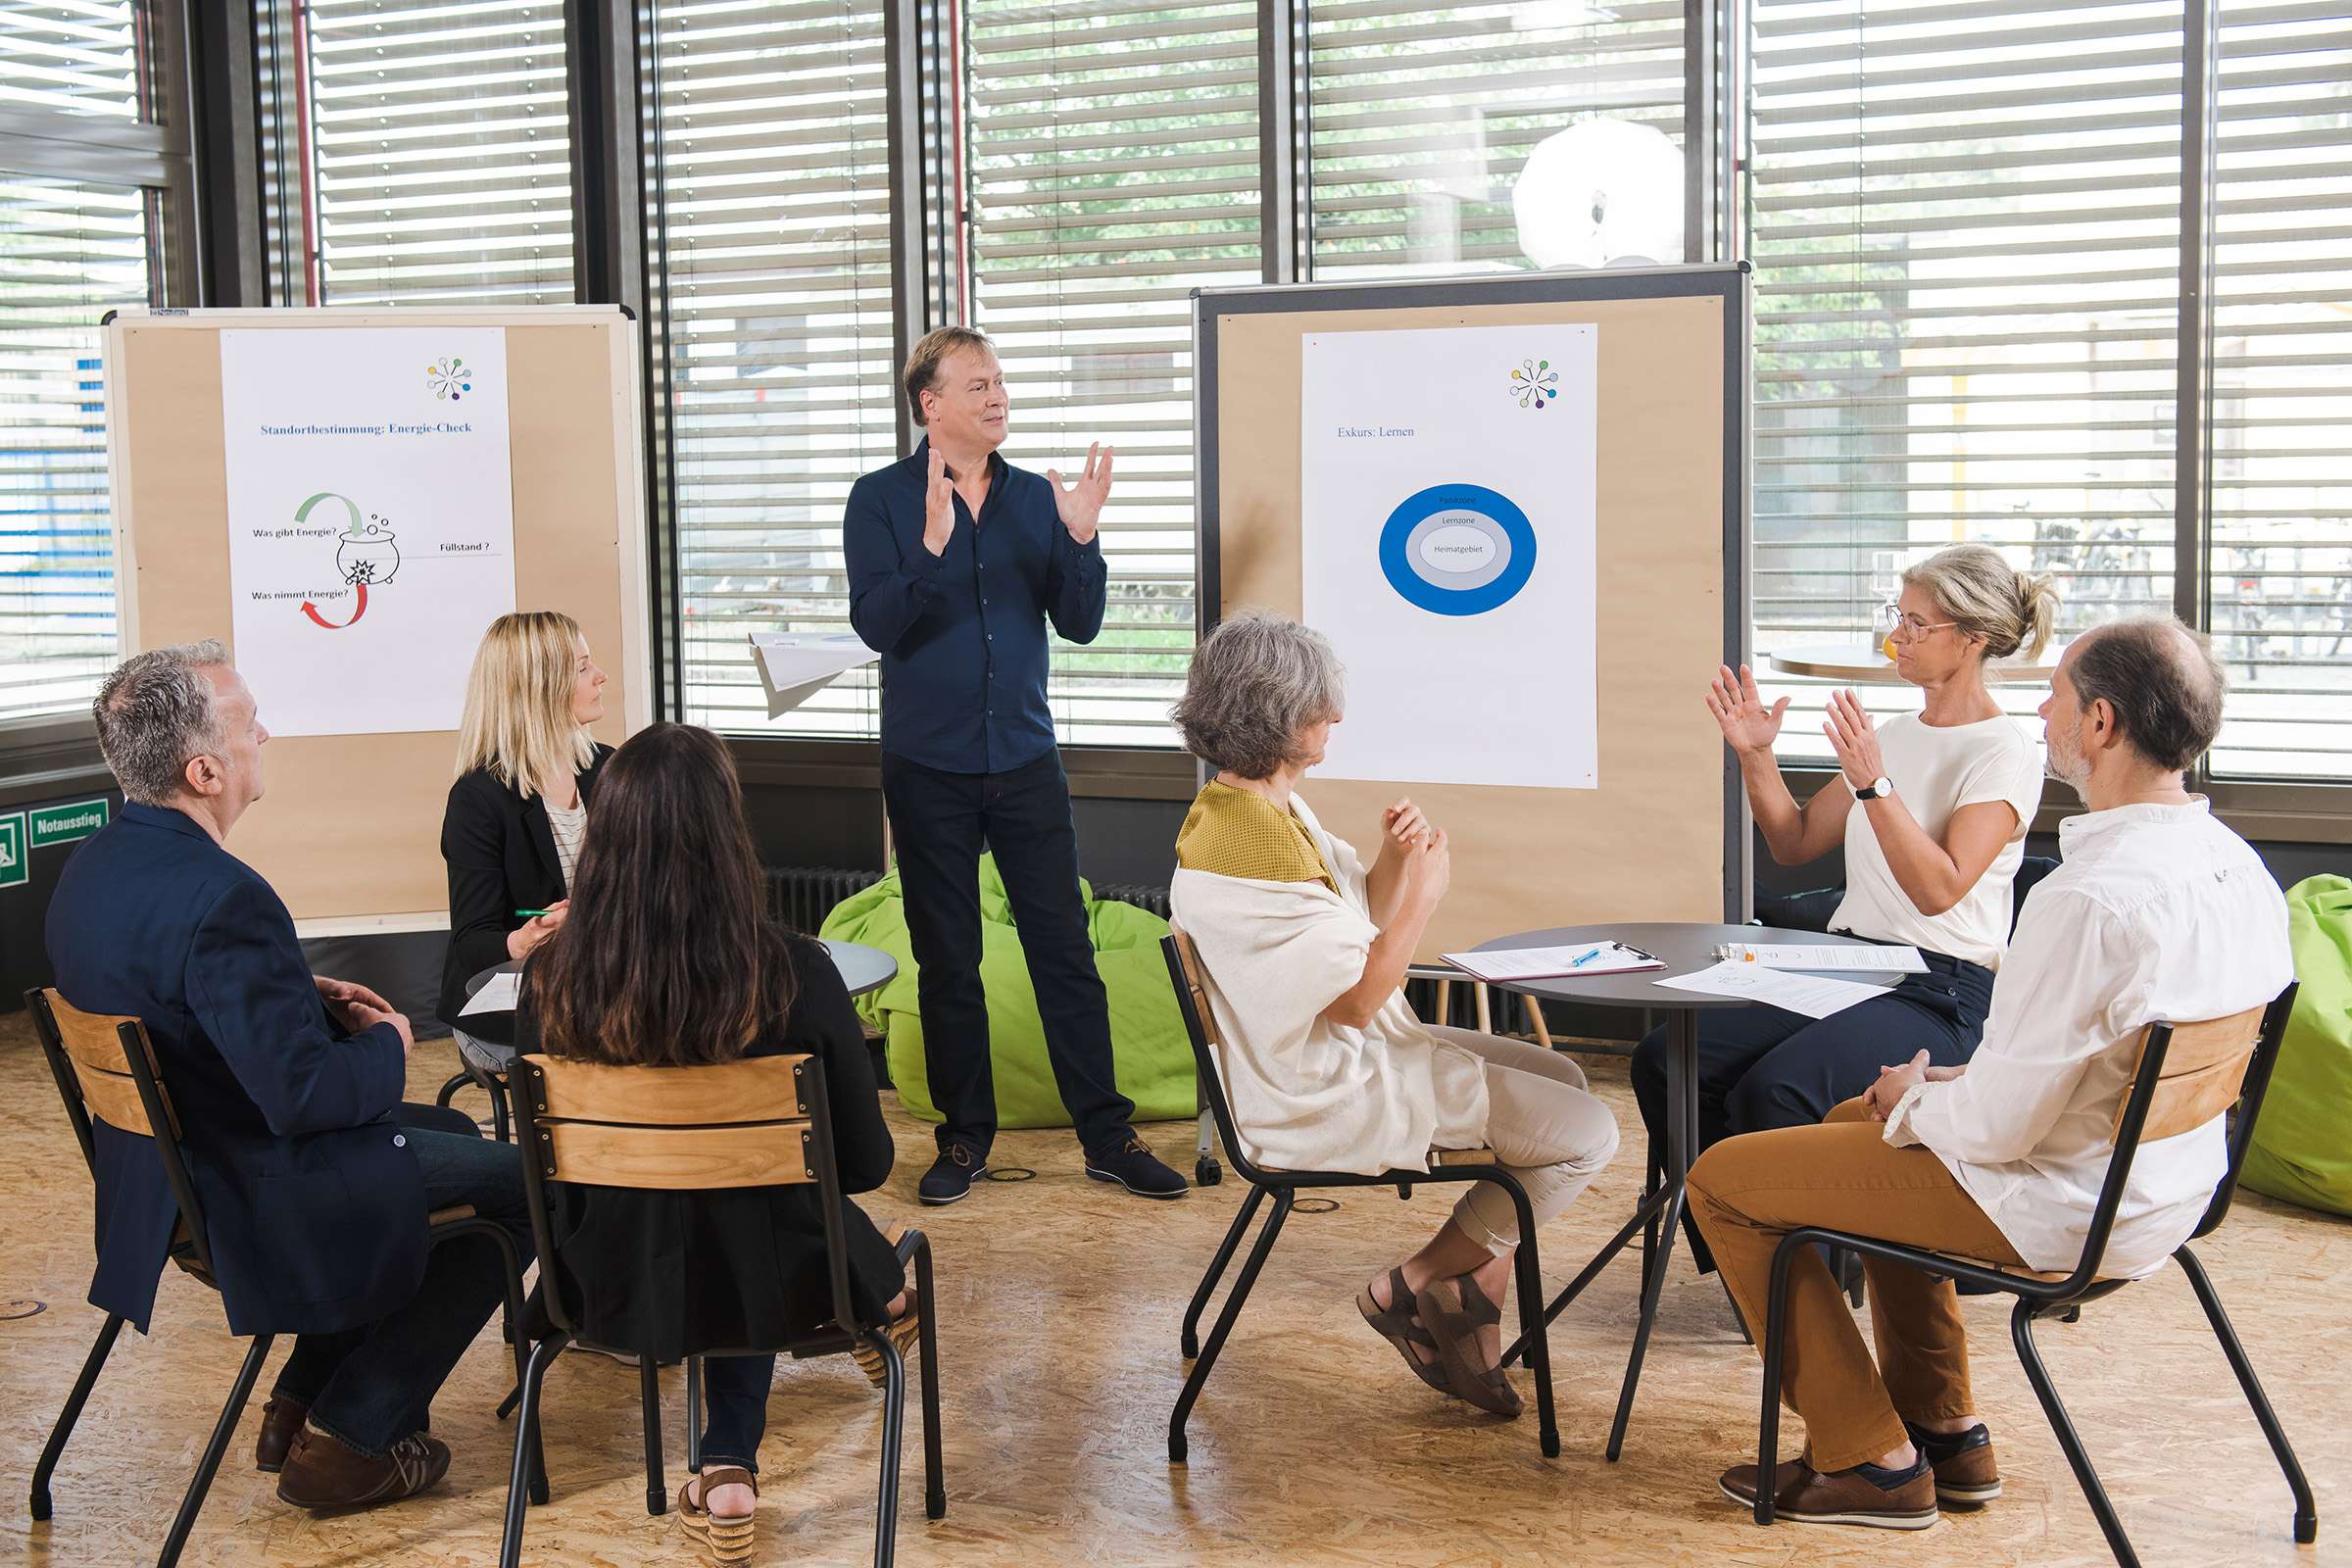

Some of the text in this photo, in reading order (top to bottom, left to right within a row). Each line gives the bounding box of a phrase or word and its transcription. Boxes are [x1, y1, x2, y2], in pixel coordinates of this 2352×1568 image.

[260, 421, 472, 436] Standortbestimmung: Energie-Check
[1337, 426, 1415, 438] Exkurs: Lernen
[253, 527, 337, 539] Was gibt Energie?
[439, 541, 490, 552] Füllstand ?
[1434, 545, 1484, 555] Heimatgebiet
[251, 589, 349, 600] Was nimmt Energie?
[37, 811, 103, 835] Notausstieg
